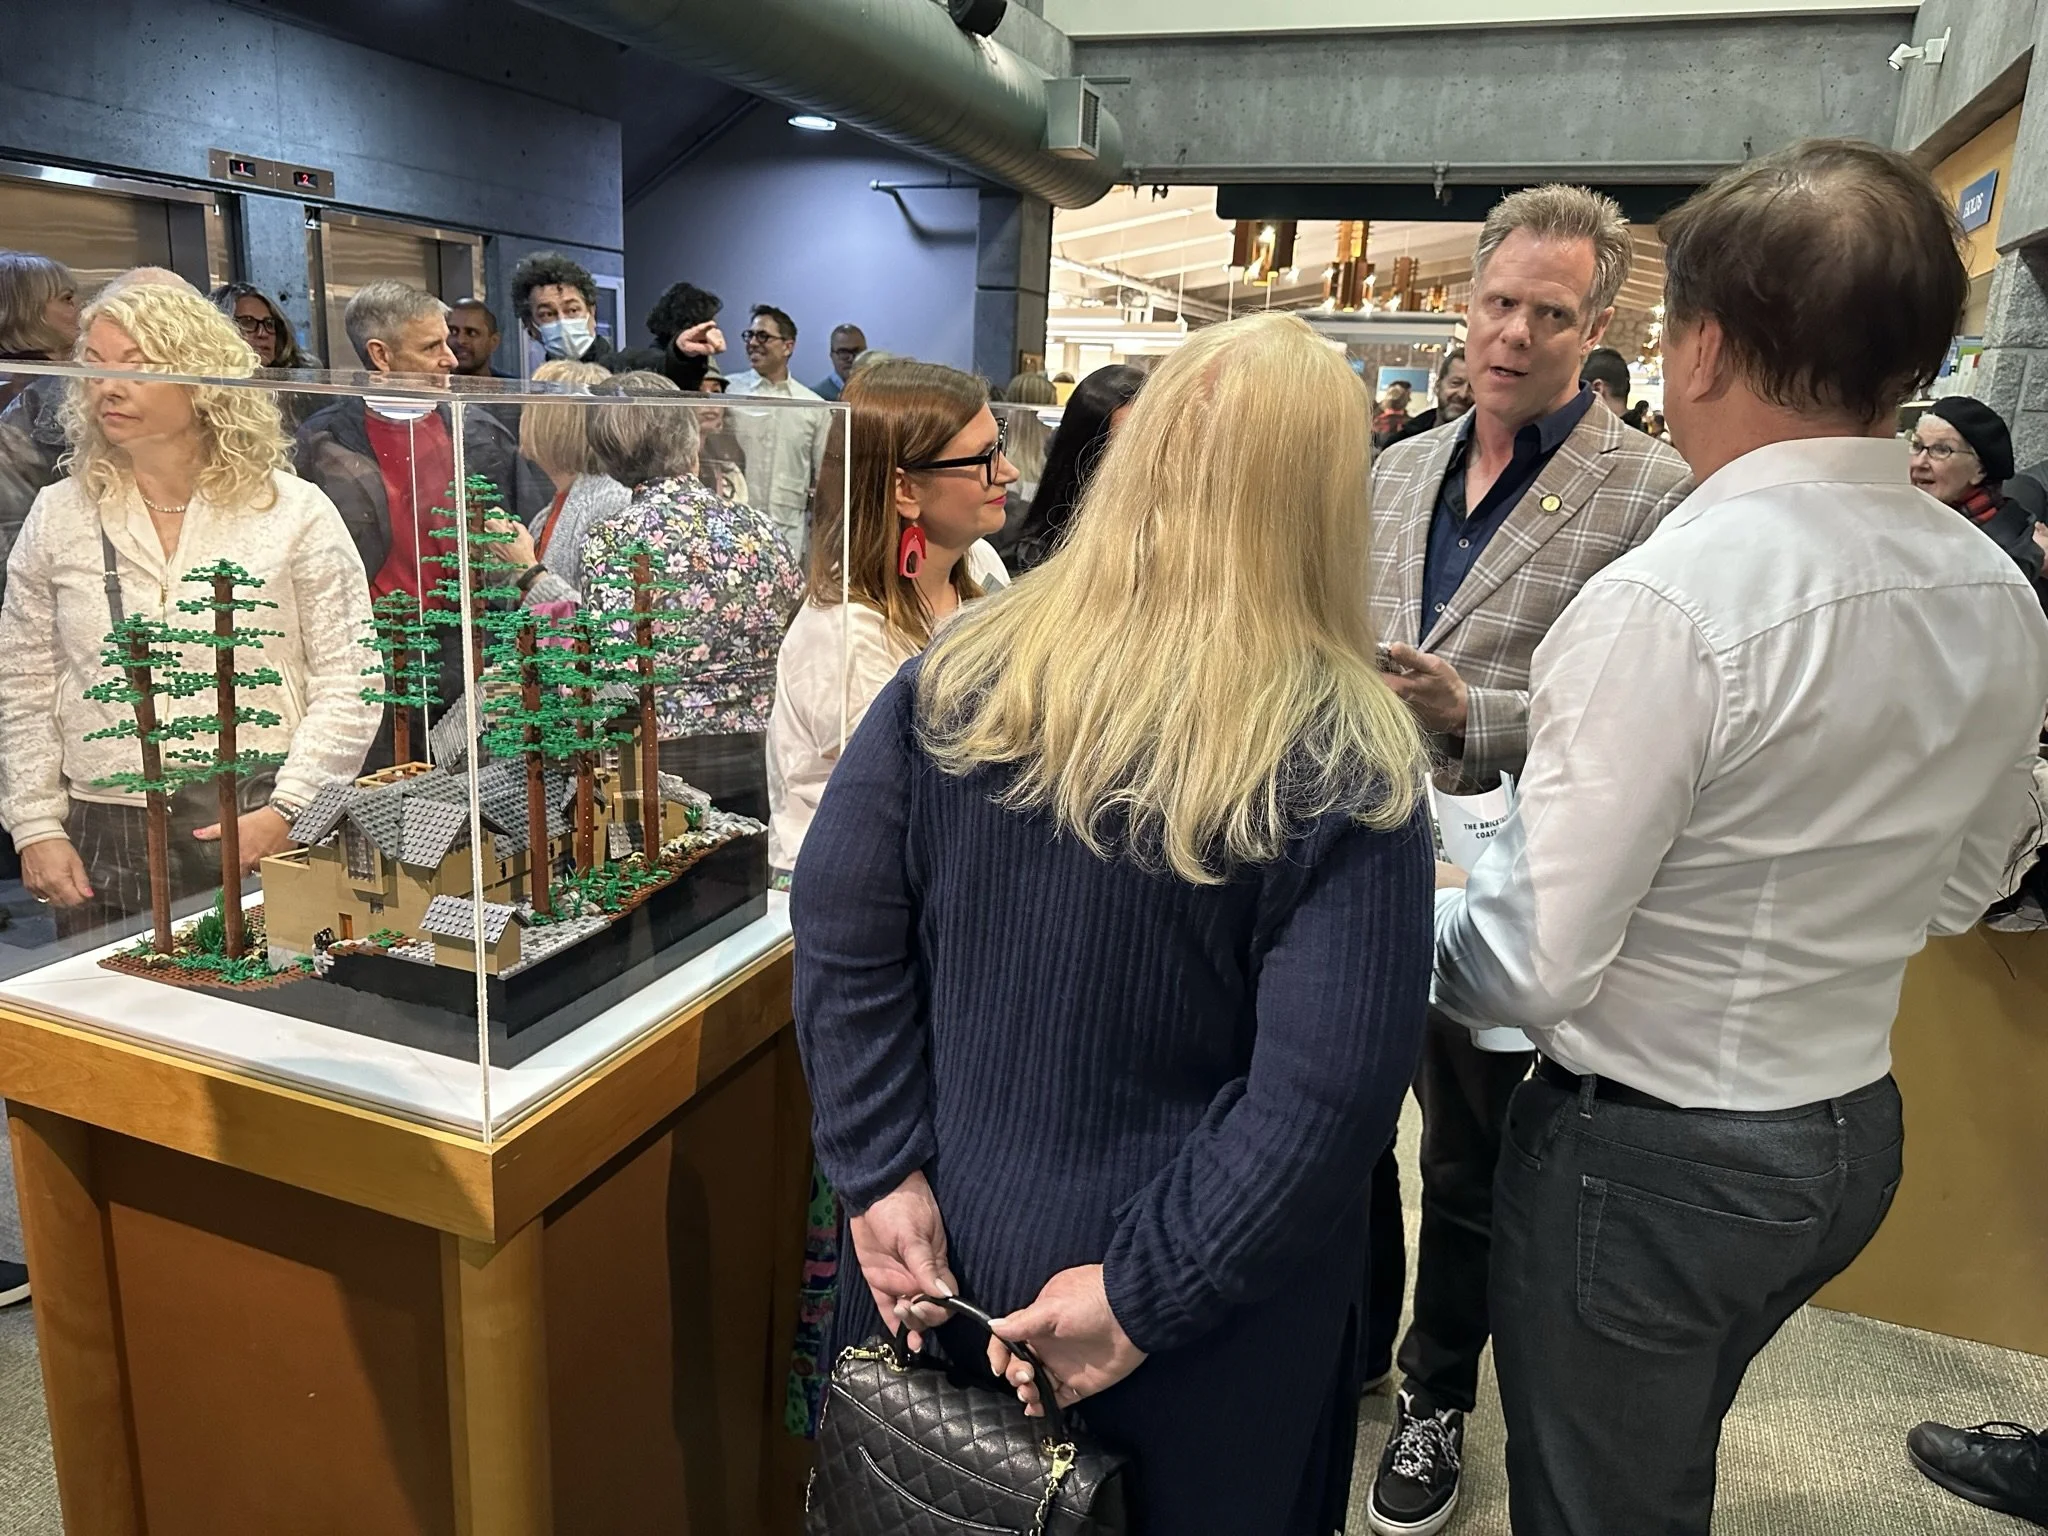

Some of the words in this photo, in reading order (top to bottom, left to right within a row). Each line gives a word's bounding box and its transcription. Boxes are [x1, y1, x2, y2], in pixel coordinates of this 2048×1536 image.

[239, 163, 245, 173] 1
[302, 174, 309, 185] 2
[305, 208, 314, 227] 2
[1475, 829, 1497, 839] COAST
